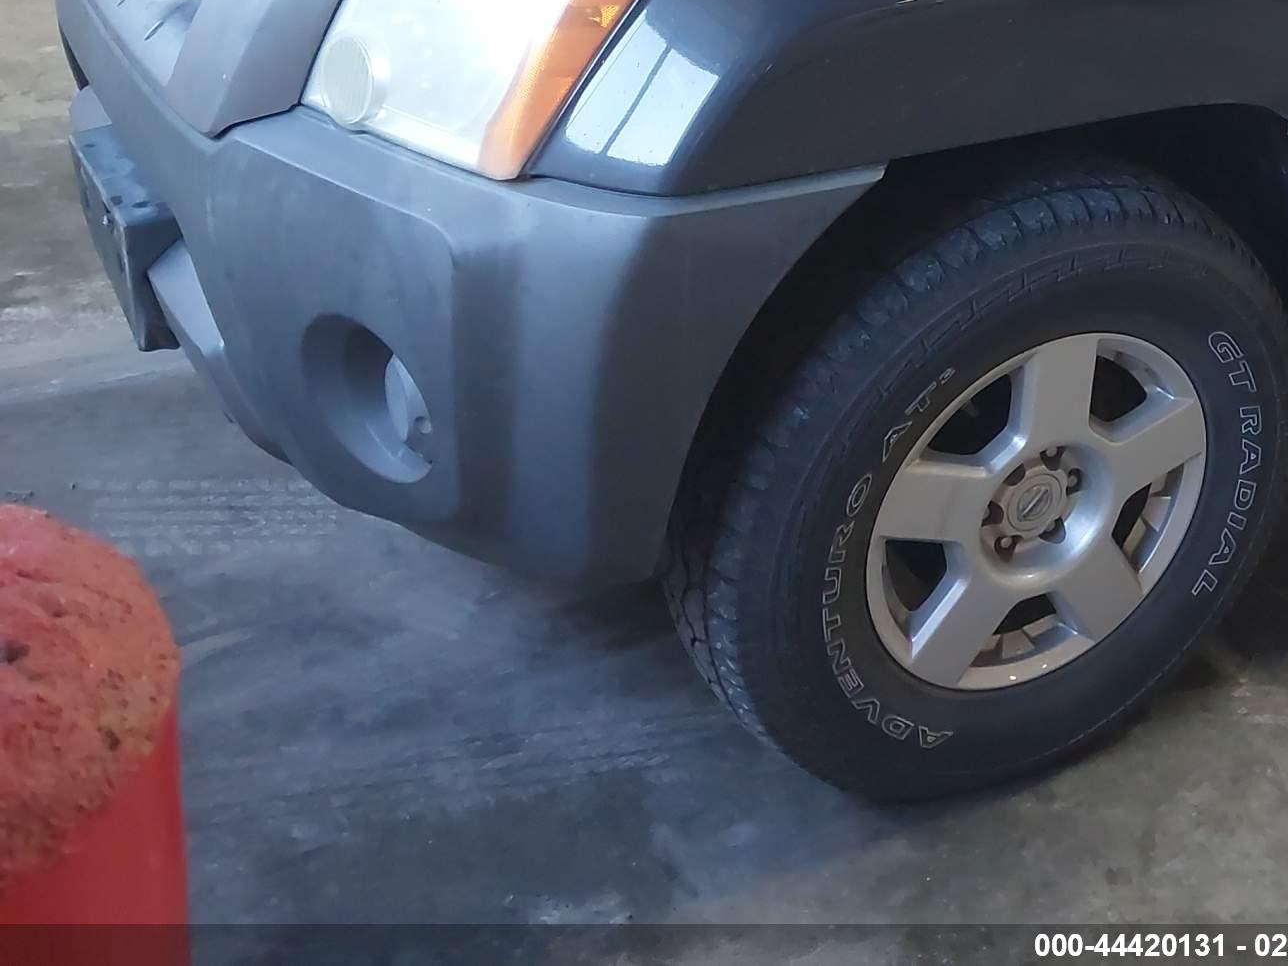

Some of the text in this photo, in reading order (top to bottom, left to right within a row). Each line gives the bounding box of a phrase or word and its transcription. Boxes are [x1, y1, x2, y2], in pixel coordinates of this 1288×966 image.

[1191, 331, 1263, 598] GT RADIAL
[822, 473, 954, 749] ADVENTURO
